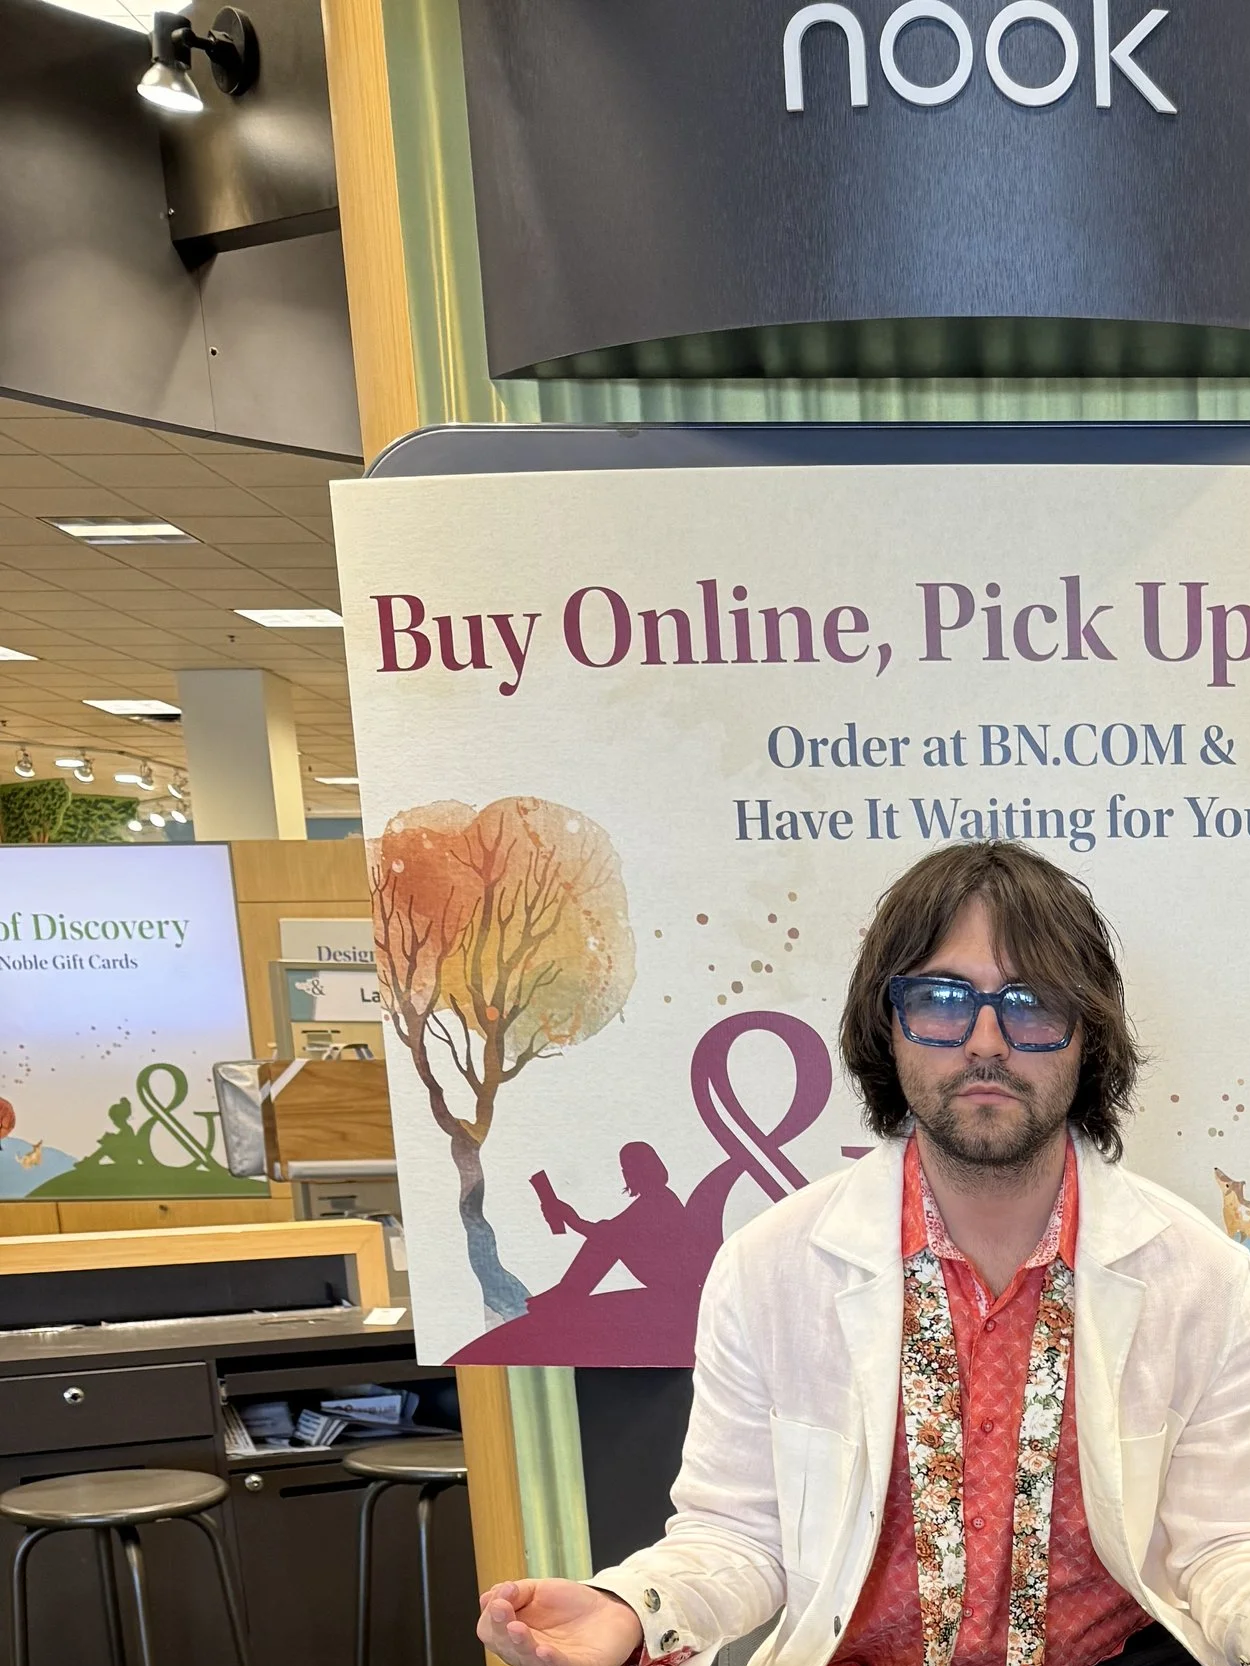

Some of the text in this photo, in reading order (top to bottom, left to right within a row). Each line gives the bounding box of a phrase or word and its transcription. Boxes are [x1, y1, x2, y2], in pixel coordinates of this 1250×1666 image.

[782, 0, 1177, 116] nook
[369, 593, 542, 697] Buy
[562, 578, 893, 678] Online,
[915, 574, 1118, 662] Pick
[767, 722, 1237, 769] Order at BN.COM &
[733, 798, 854, 841] Have
[864, 797, 901, 841] It
[908, 797, 1097, 853] Waiting
[1106, 793, 1174, 840] for
[0, 911, 190, 949] of Discovery
[0, 953, 139, 971] Noble Gift Cards
